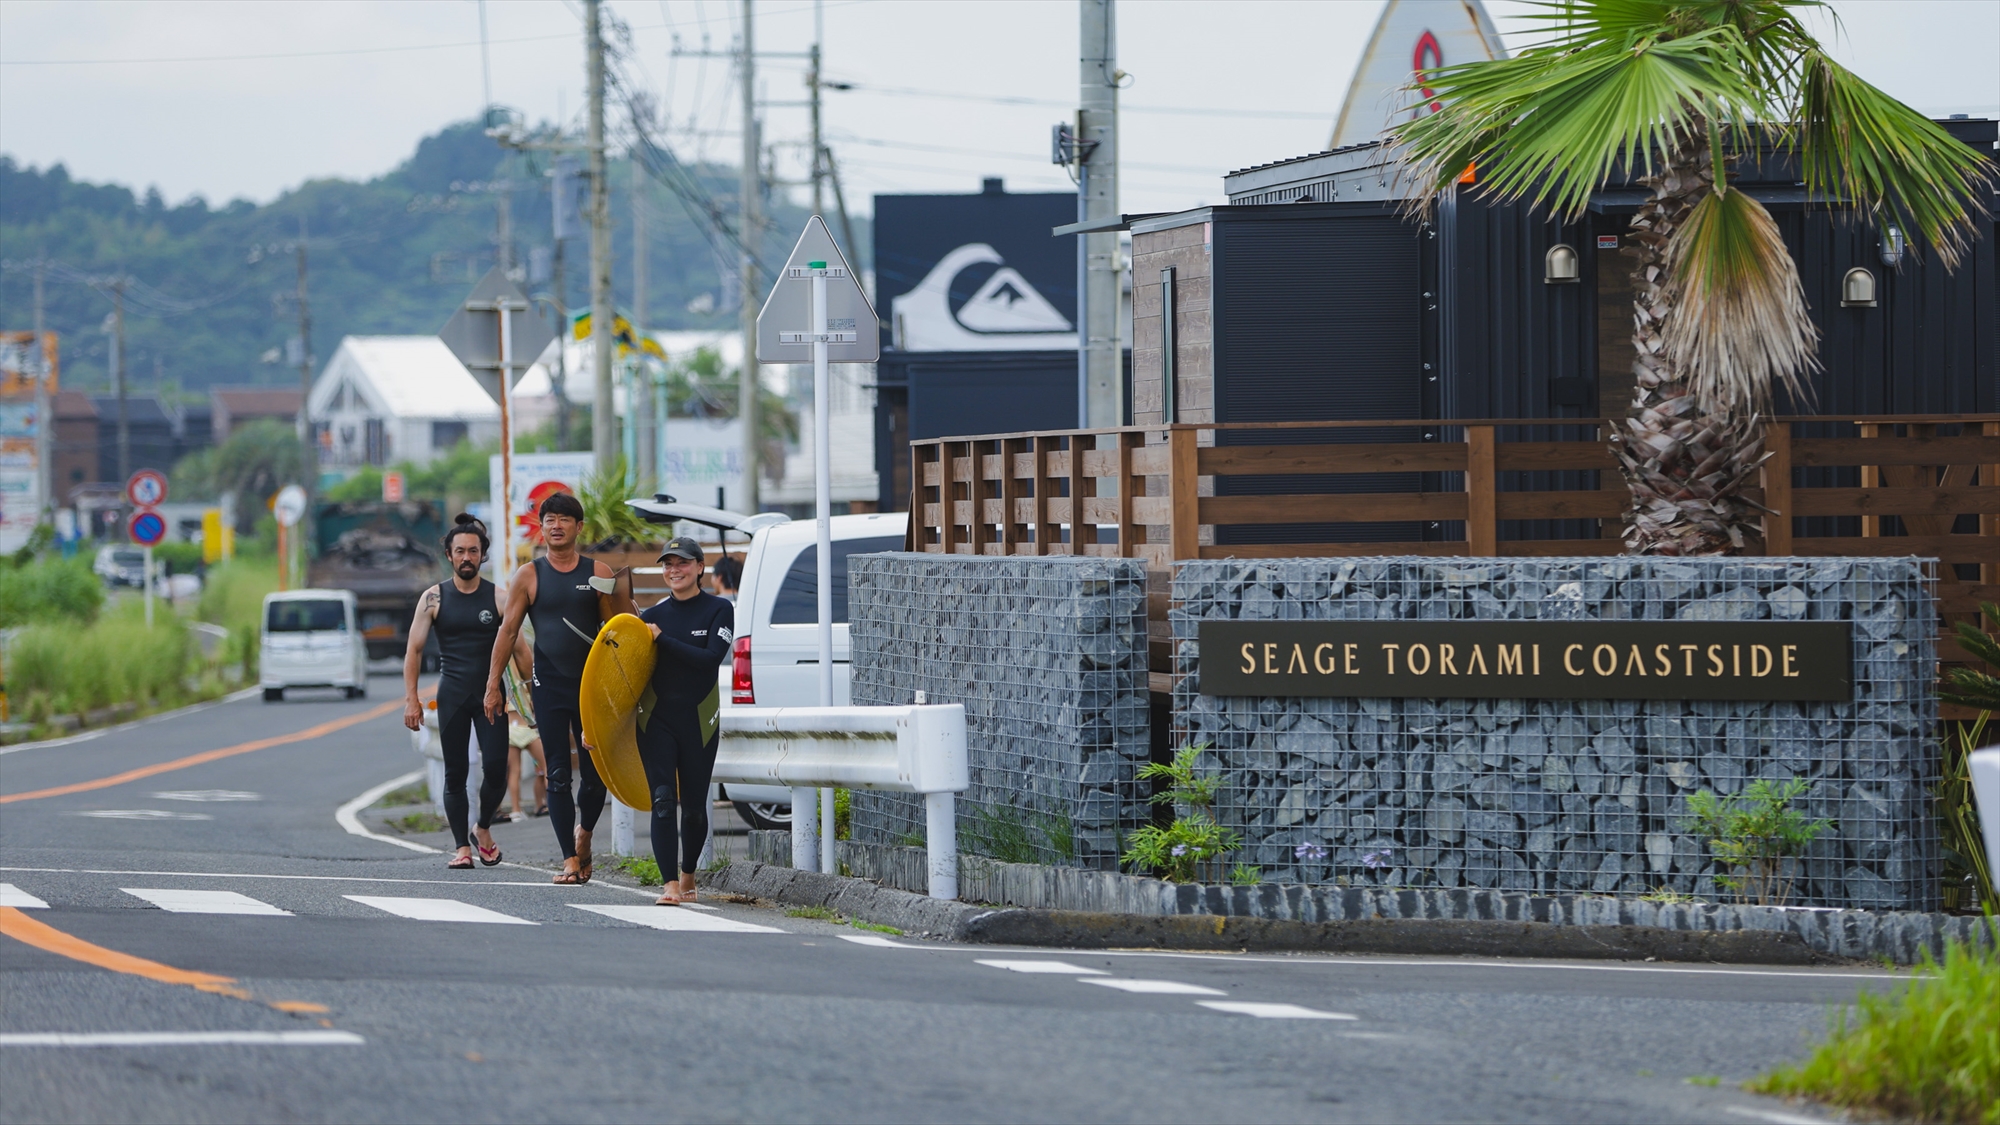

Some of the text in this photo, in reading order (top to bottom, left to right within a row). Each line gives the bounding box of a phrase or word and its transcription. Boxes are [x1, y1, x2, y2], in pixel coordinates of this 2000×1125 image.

[1241, 642, 1800, 677] SEAGE TORAMI COASTSIDE
